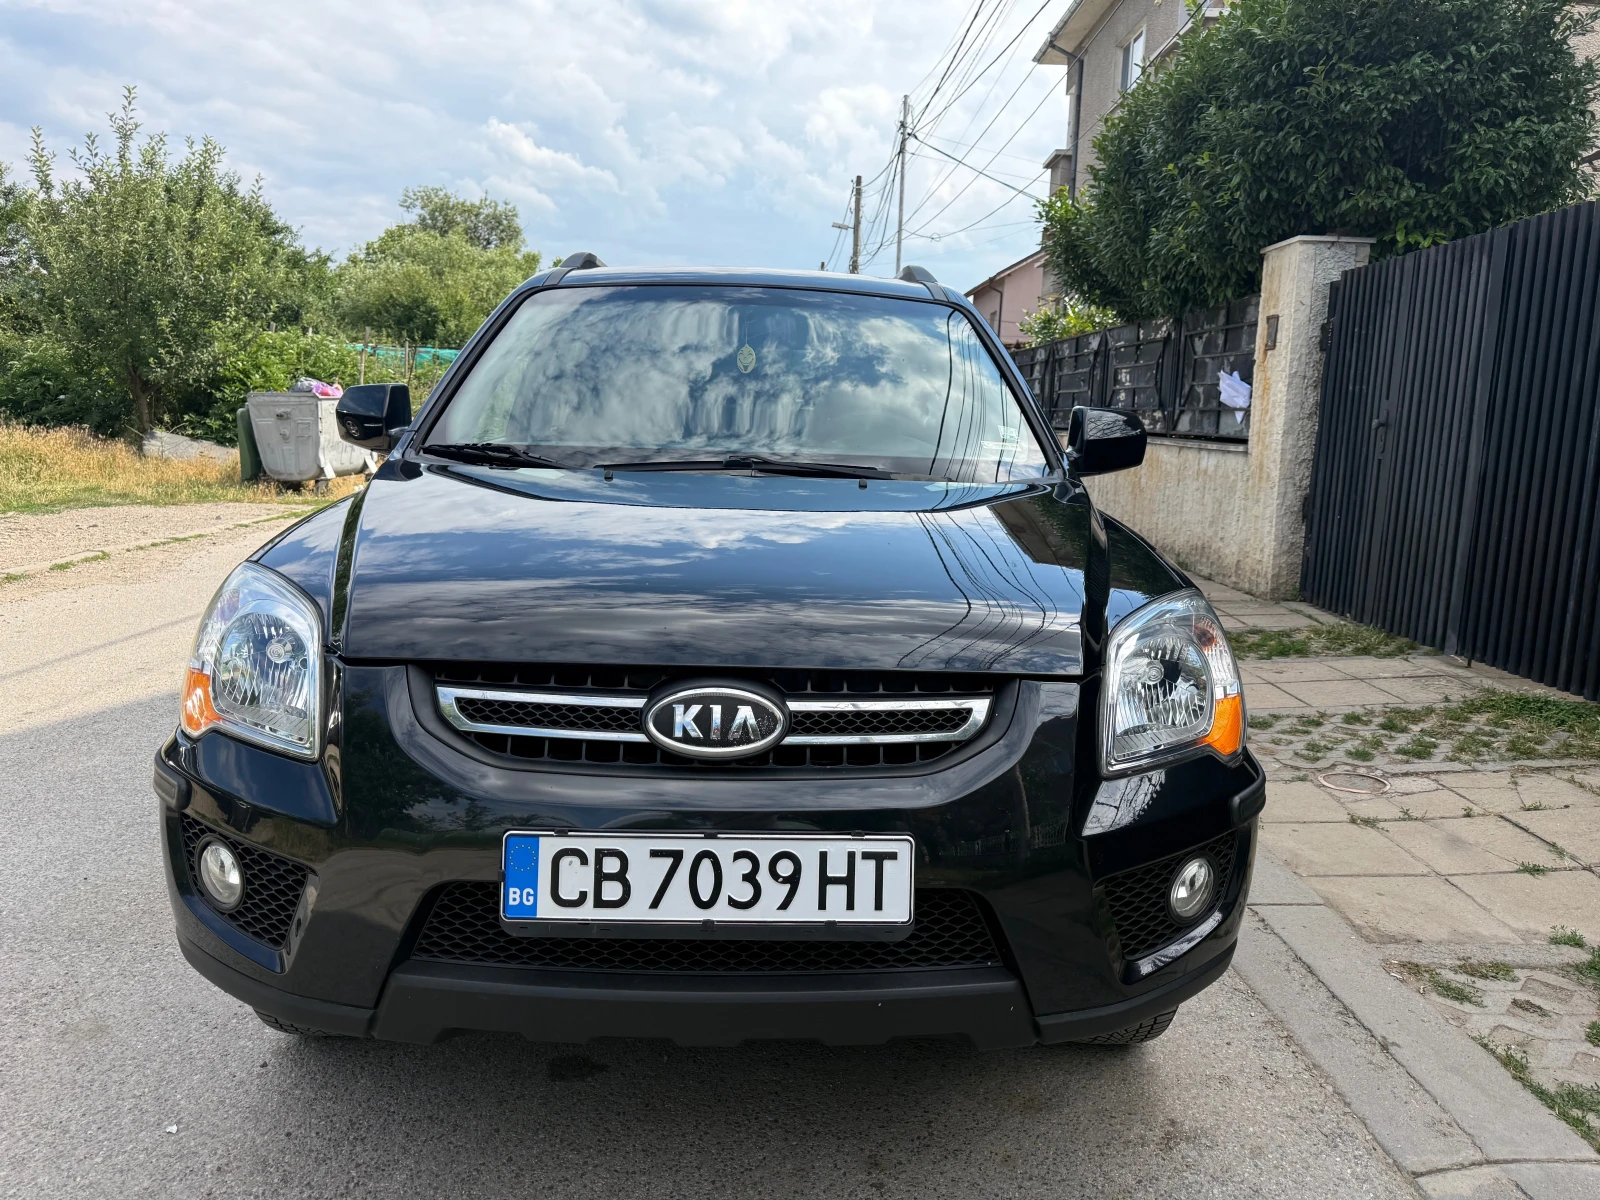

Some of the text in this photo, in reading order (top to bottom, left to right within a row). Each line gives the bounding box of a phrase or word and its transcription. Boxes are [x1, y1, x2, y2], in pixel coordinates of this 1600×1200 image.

[672, 704, 762, 740] KIA
[508, 887, 535, 906] BG
[550, 848, 898, 911] CB 7039 HT
